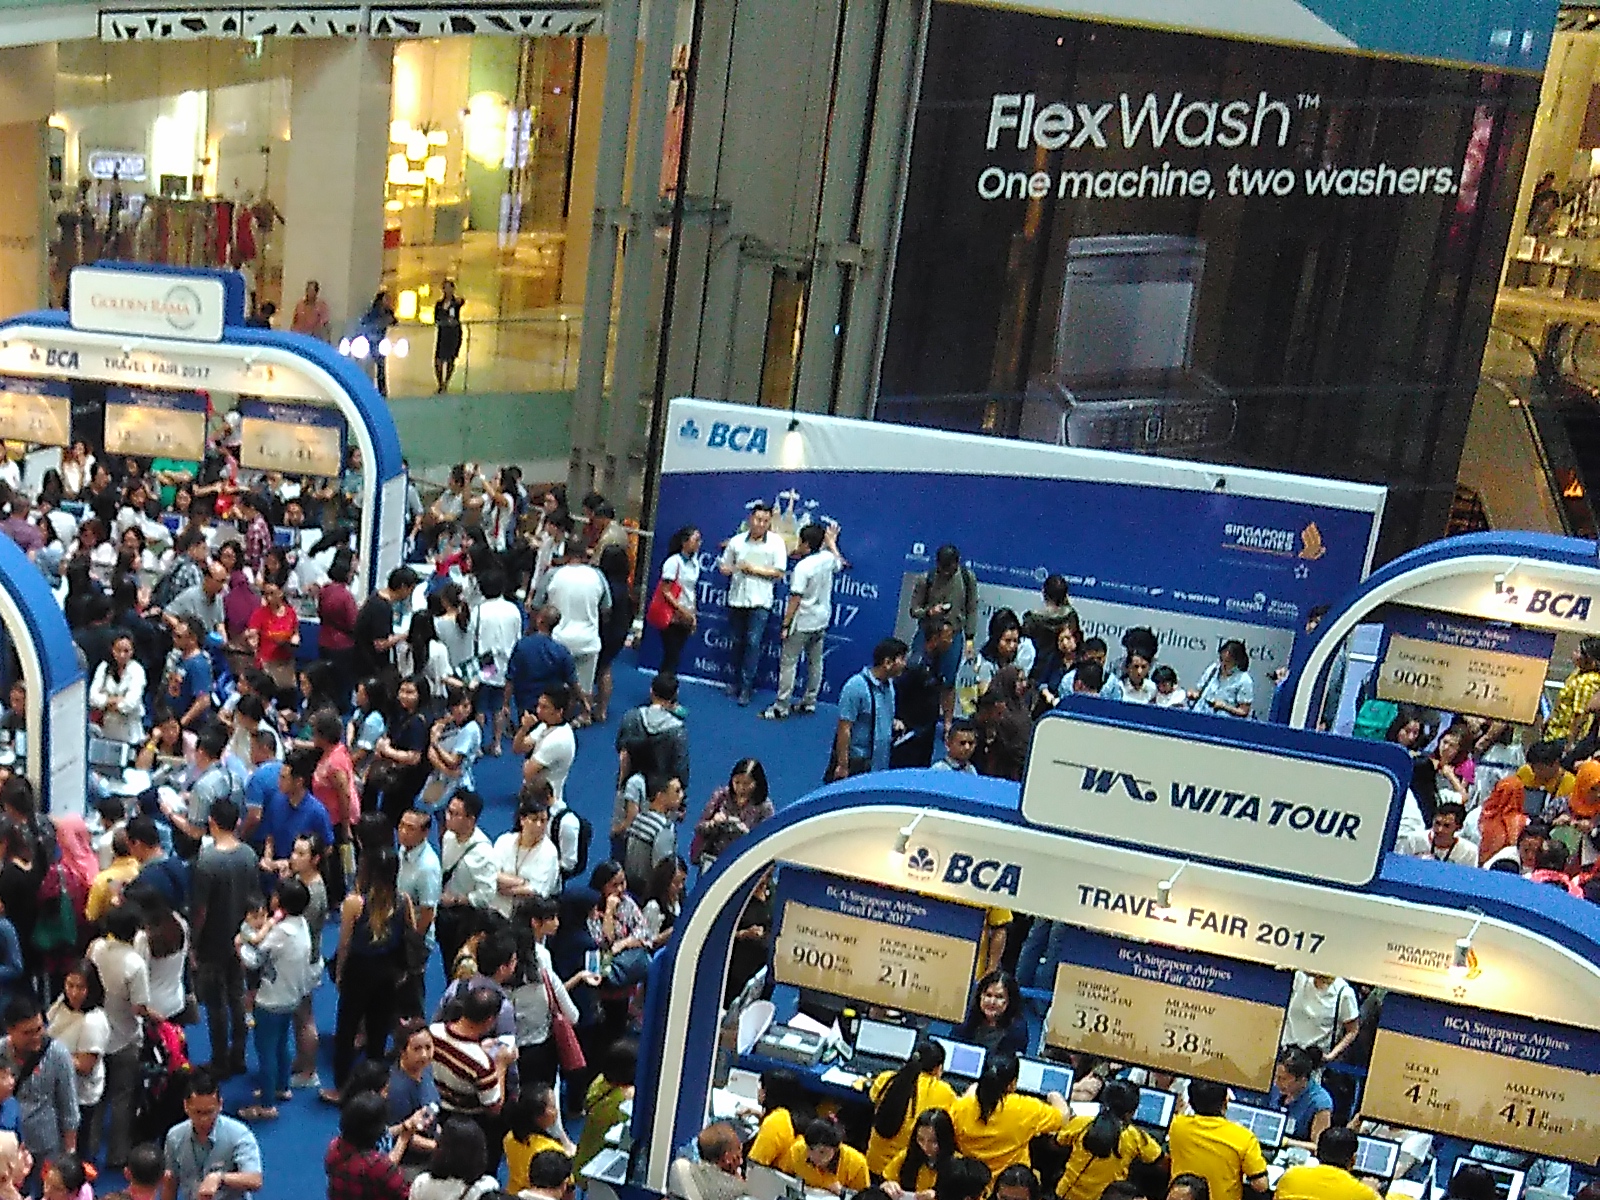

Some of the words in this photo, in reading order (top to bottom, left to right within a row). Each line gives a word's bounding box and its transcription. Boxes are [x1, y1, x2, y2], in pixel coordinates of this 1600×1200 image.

[977, 166, 1050, 200] One
[1058, 161, 1217, 200] machine,
[1227, 164, 1295, 196] two
[1304, 163, 1460, 195] washers.
[46, 349, 80, 371] BCA
[707, 421, 768, 454] BCA
[833, 603, 859, 627] 17
[1526, 588, 1593, 621] BCA
[1393, 668, 1429, 688] 900
[1169, 780, 1261, 823] WITA
[1268, 799, 1362, 841] TOUR
[941, 851, 1023, 898] BCA
[1187, 907, 1248, 939] FAIR
[1258, 923, 1326, 955] 2017
[792, 944, 835, 970] 900
[1118, 948, 1143, 963] BCA
[1143, 951, 1193, 976] Singapore
[1133, 963, 1162, 981] Travel
[1072, 1009, 1111, 1034] 3,8
[1160, 1028, 1200, 1055] 3,8
[1444, 1016, 1471, 1031] BCA
[1472, 1022, 1528, 1044] Singapore
[1528, 1032, 1571, 1051] Airlines
[1460, 1033, 1493, 1051] Travel
[1494, 1039, 1517, 1056] Fair
[1519, 1044, 1551, 1060] 2017
[1403, 1083, 1423, 1105] 4
[1499, 1102, 1537, 1127] 4,1
